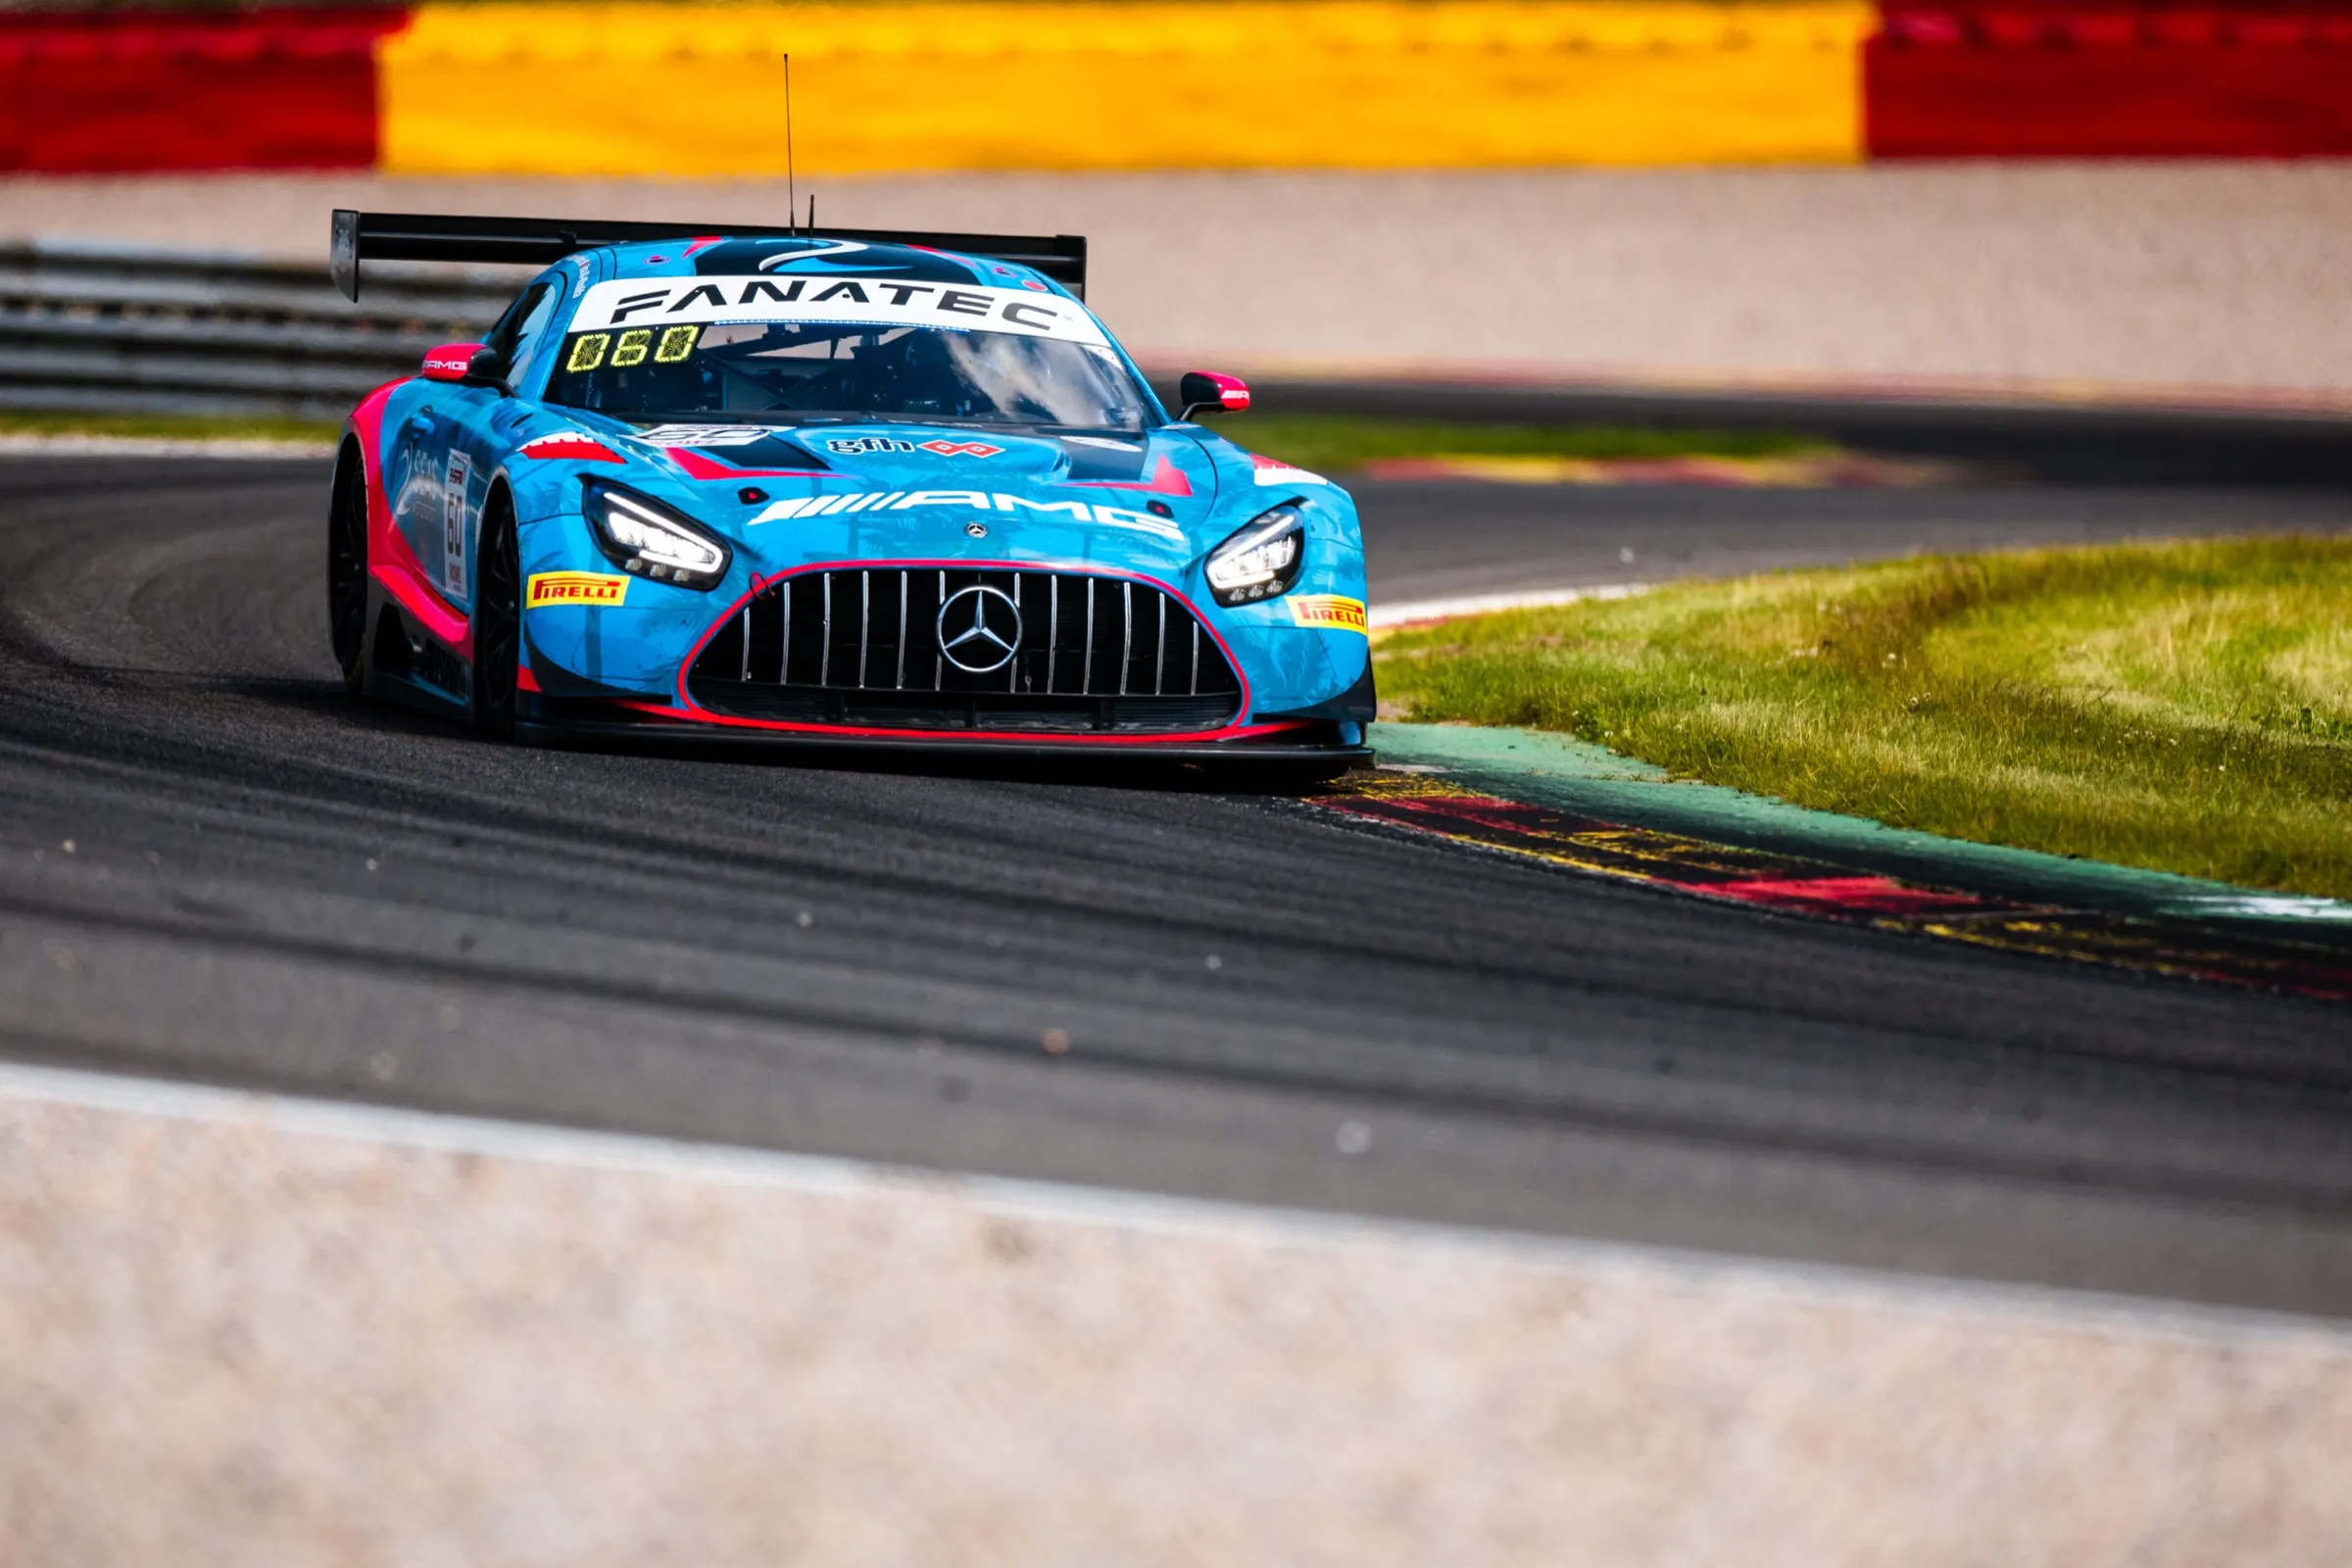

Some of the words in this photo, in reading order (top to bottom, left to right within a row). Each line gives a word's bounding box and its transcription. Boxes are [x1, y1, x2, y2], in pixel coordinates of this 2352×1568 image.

[610, 280, 1058, 330] FANATEC
[426, 360, 467, 371] AMG
[566, 325, 699, 373] 060
[826, 437, 915, 455] gfh
[447, 493, 463, 557] 60
[891, 491, 1185, 541] AMG
[533, 577, 621, 601] PIRELLI
[1298, 601, 1364, 627] PIRELLI
